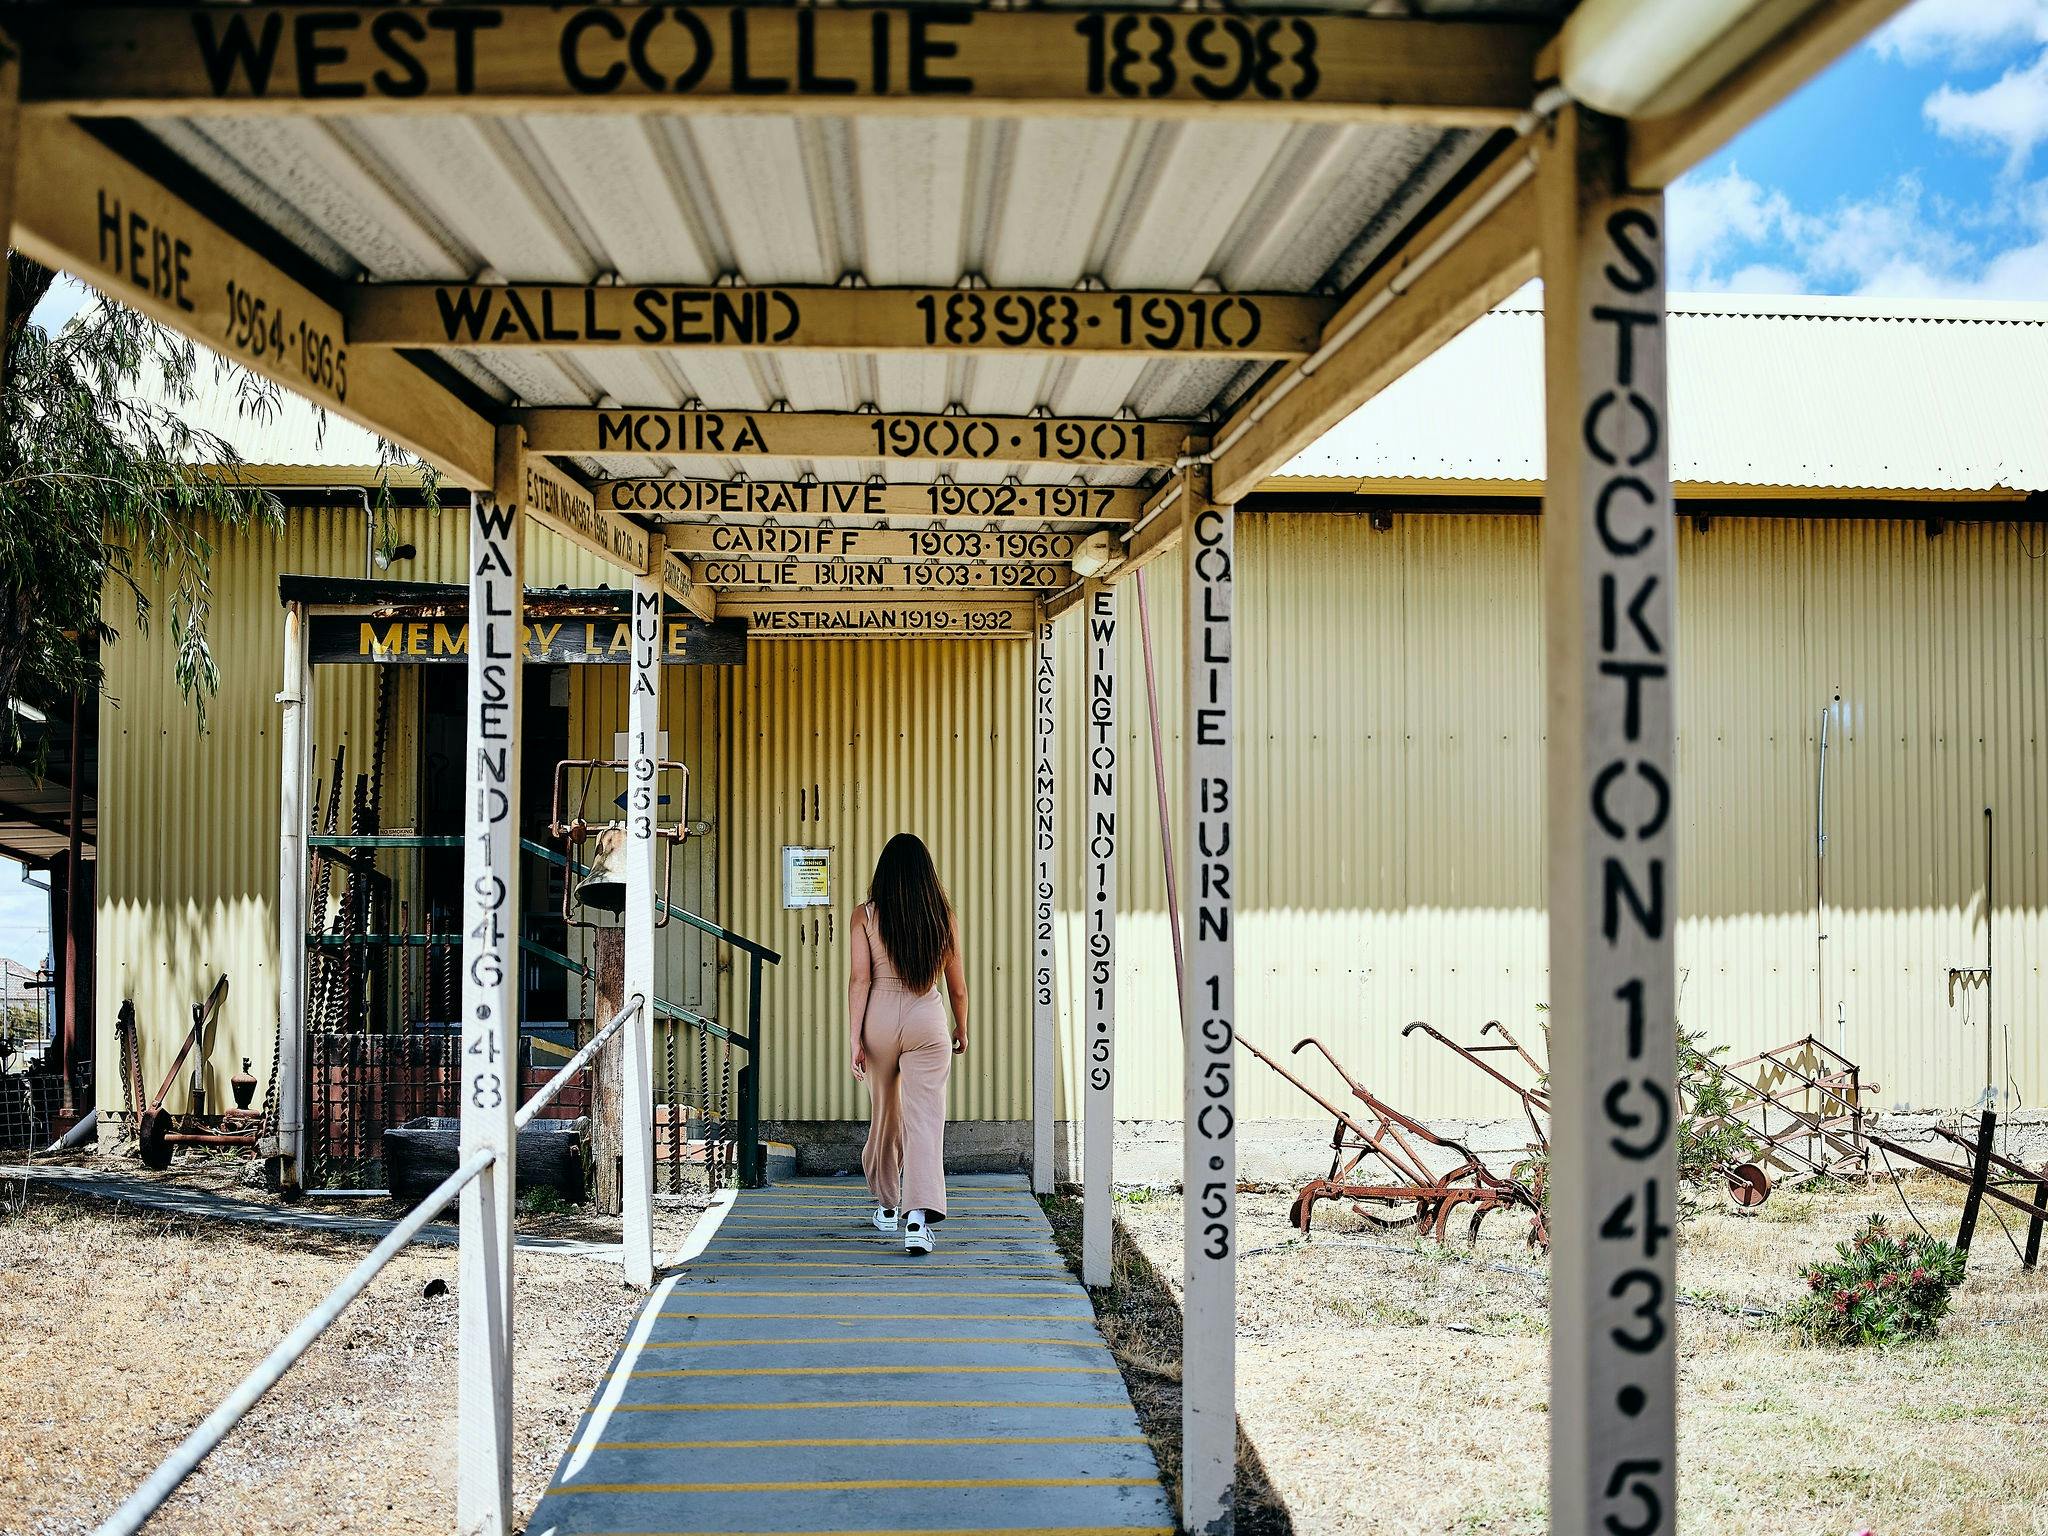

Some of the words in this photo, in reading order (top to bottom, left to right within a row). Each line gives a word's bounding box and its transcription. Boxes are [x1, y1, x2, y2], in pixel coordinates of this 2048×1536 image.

[192, 10, 500, 97] WEST
[560, 8, 974, 96] COLLIE
[1075, 14, 1322, 101] 1898
[98, 189, 195, 313] HEBE
[435, 288, 801, 343] WALLSEND
[599, 413, 768, 454] MOIRA
[526, 467, 560, 518] ESTERN
[611, 481, 886, 515] COOPERATIVE
[705, 562, 797, 585] COLLIE
[814, 563, 885, 585] BURN
[712, 527, 860, 554] CARDIFF
[1583, 208, 1671, 946] STOCKTON
[359, 622, 562, 656] MEMRY
[585, 622, 688, 656] LAE
[475, 503, 517, 823] WALLSEND
[632, 592, 659, 697] MUJA
[753, 610, 897, 629] WESTRALIAN
[1194, 510, 1231, 745] COLLIE
[1091, 592, 1116, 796] EWINGTON
[633, 731, 655, 840] 1953
[1199, 777, 1230, 942] BURN
